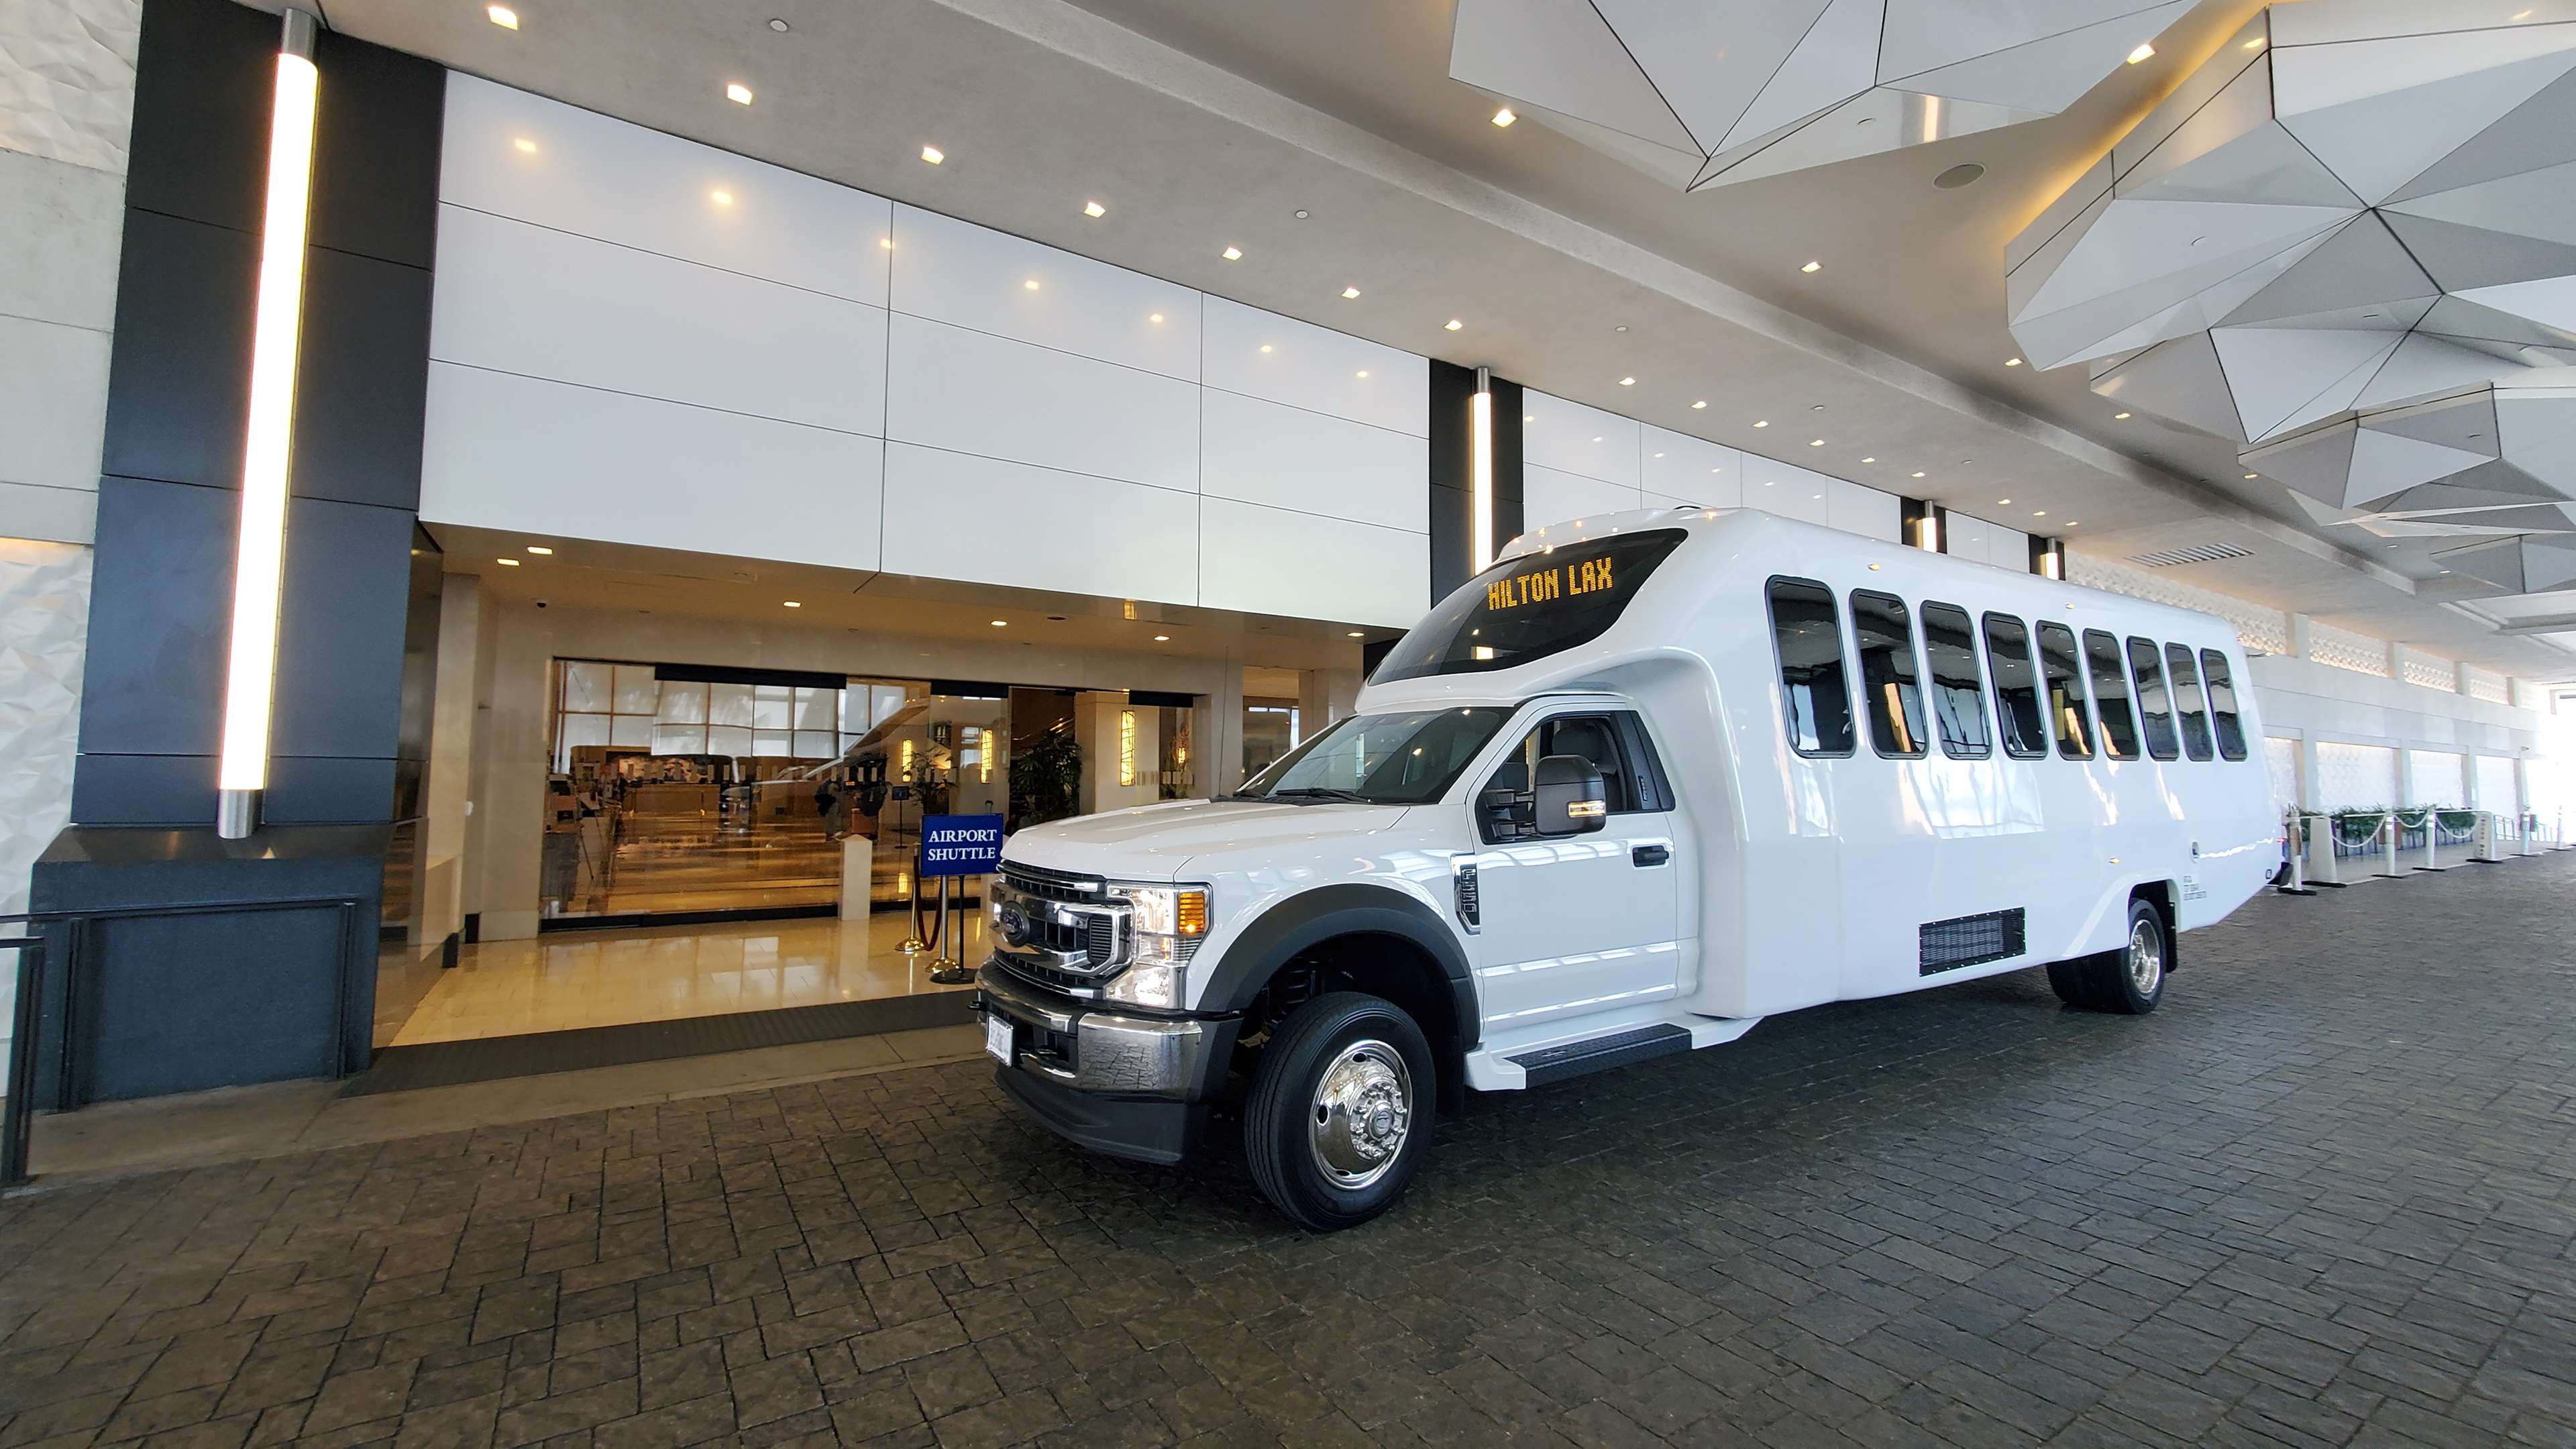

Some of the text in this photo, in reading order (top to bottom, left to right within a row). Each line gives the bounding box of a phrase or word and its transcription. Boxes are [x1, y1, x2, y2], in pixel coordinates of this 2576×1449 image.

[1487, 557, 1614, 610] HILTON LAX
[928, 829, 997, 843] AIRPORT
[928, 847, 996, 861] SHUTTLE
